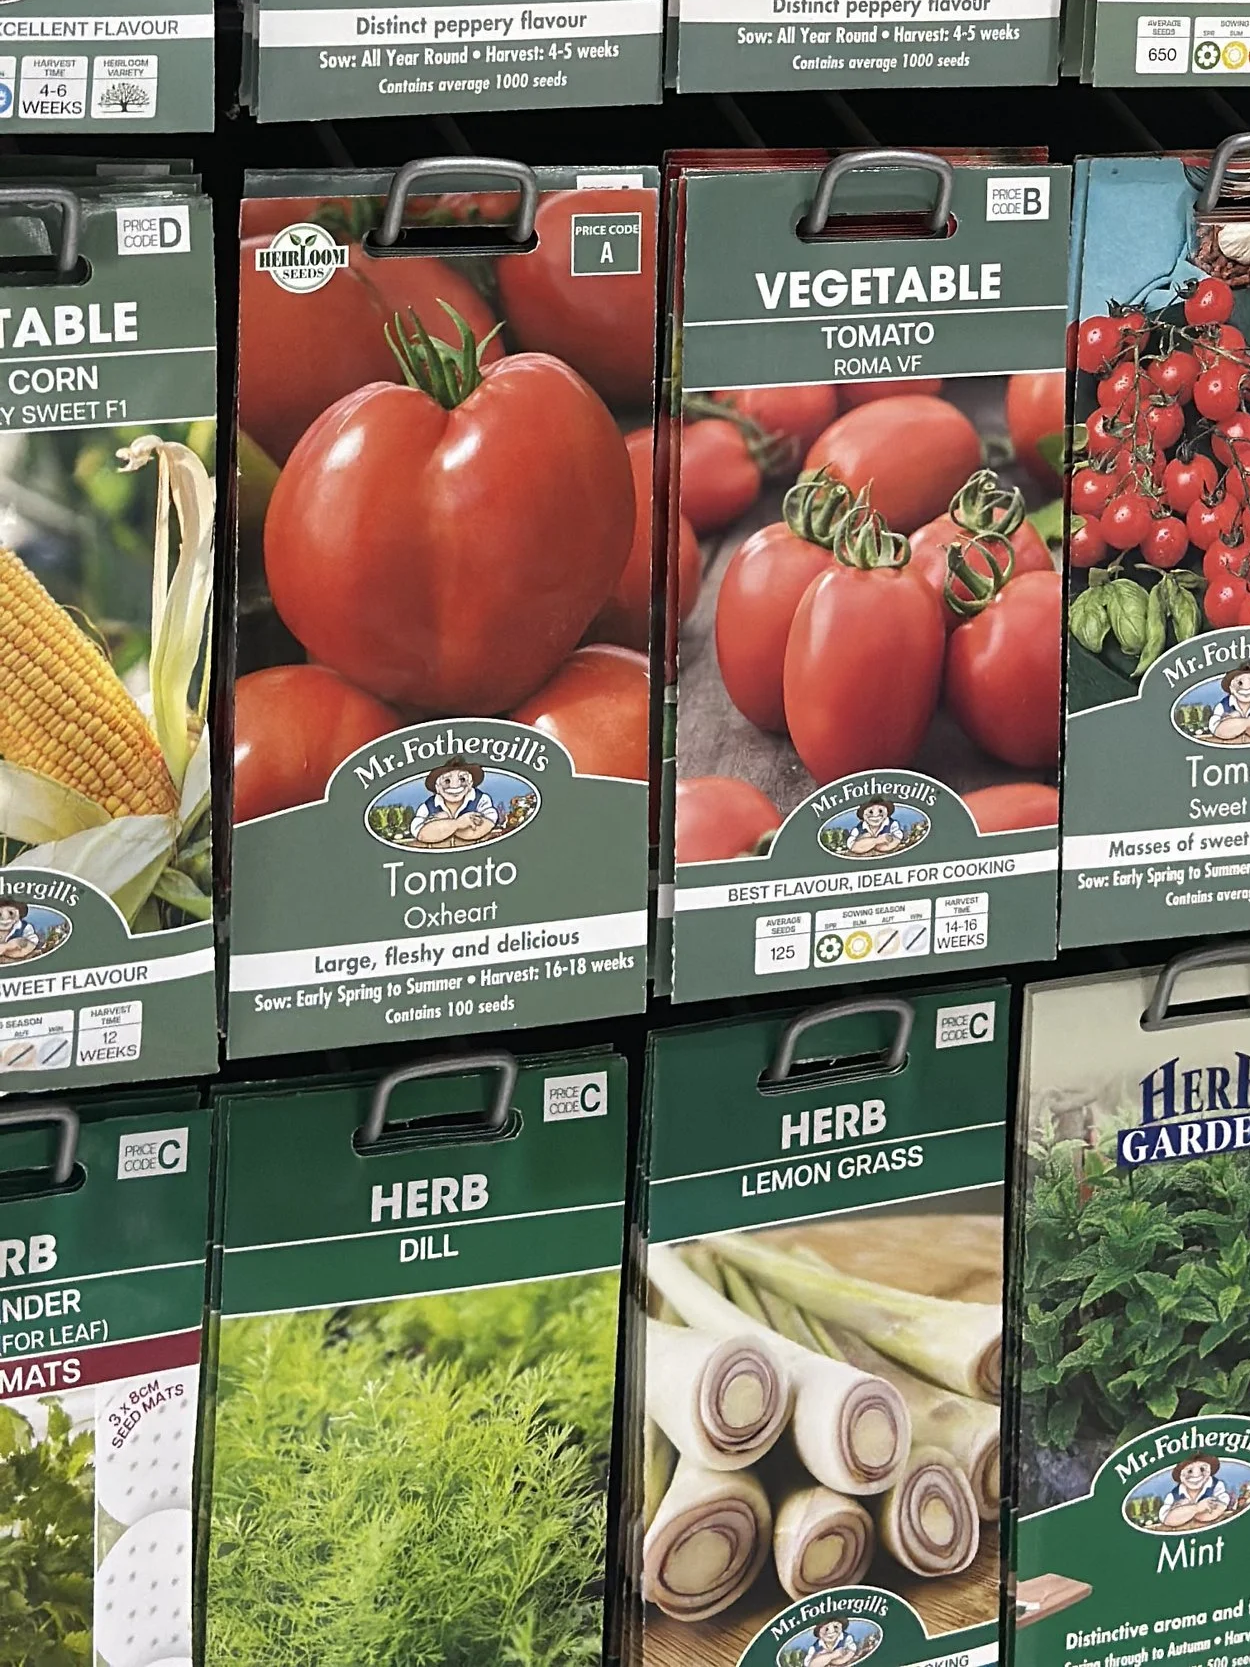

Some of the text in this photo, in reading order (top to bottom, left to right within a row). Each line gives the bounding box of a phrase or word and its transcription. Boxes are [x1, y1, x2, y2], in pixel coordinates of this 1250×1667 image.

[94, 20, 179, 37] FLAVOUR
[356, 9, 587, 38] Distinct peppery flavour
[319, 39, 620, 70] Sow: All Year Round Harvest: 4-5 weeks
[1148, 47, 1177, 62] 650
[40, 84, 67, 97] 4-6
[23, 101, 82, 115] WEEKS
[1023, 187, 1041, 216] B
[159, 218, 182, 247] D
[259, 244, 346, 268] HEIRLOOM
[283, 268, 325, 279] SEEDS
[754, 262, 1002, 310] VEGETABLE
[821, 321, 935, 350] TOMATO
[834, 355, 922, 376] ROMA VF
[8, 366, 98, 395] CORN
[22, 400, 127, 424] SWEET F1
[1189, 796, 1248, 819] Sweet
[383, 856, 517, 897] Tomato
[728, 859, 1016, 903] BEST FLAVOUR, IDEAL FOR COOKING
[404, 901, 498, 930] Oxheart
[770, 945, 795, 961] 125
[104, 1031, 117, 1043] 12
[80, 1044, 137, 1062] WEEKS
[580, 1083, 601, 1112] C
[781, 1099, 886, 1150] HERB
[742, 1145, 924, 1197] LEMON GRASS
[371, 1173, 489, 1223] HERB
[400, 1234, 459, 1263] DILL
[50, 1319, 109, 1347] LEAF)
[112, 1384, 184, 1449] SEED MATS
[1156, 1535, 1224, 1574] Mint
